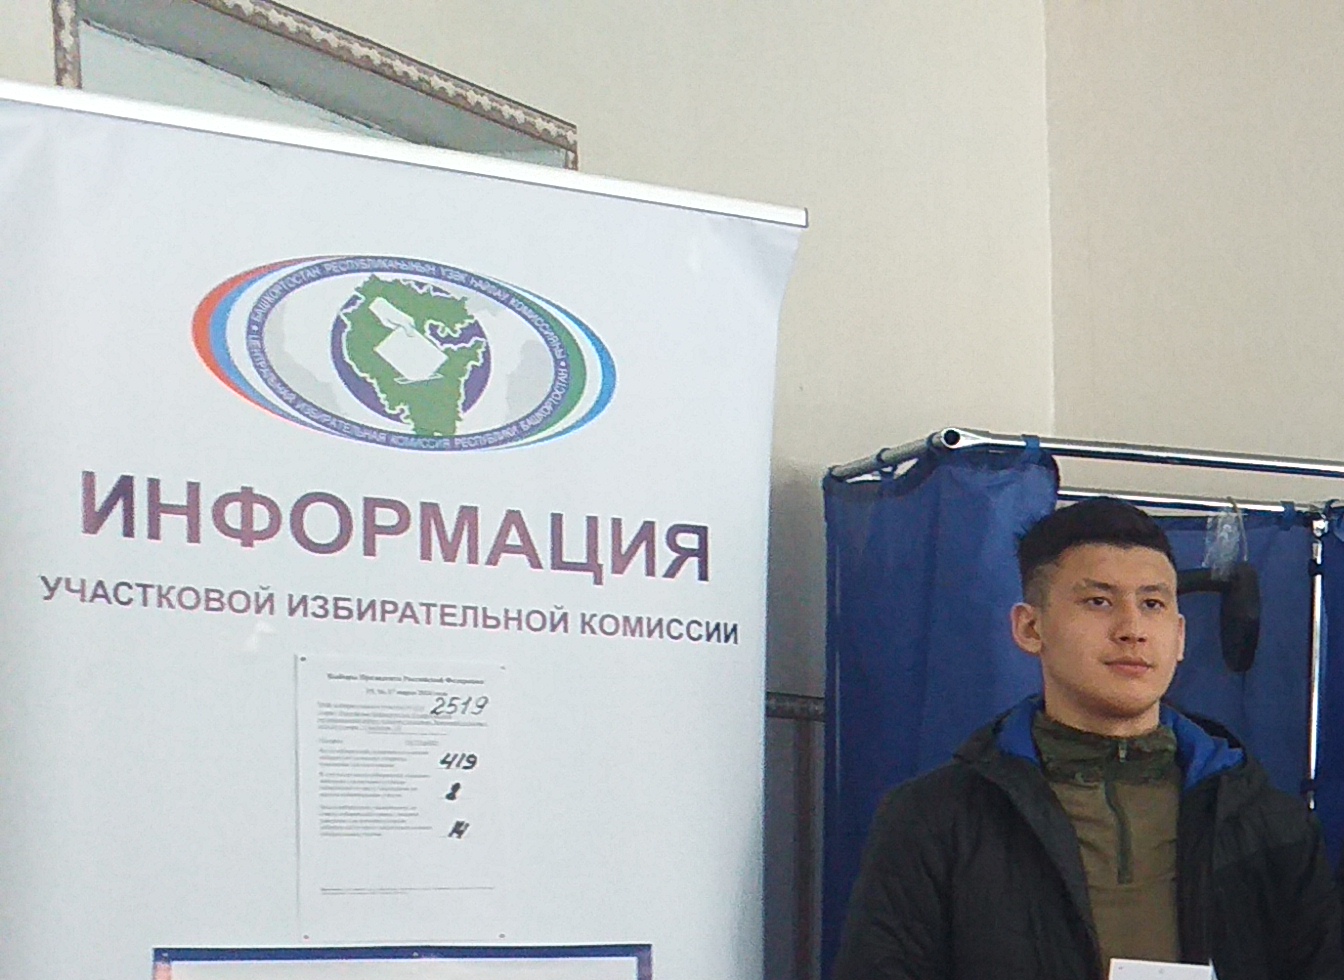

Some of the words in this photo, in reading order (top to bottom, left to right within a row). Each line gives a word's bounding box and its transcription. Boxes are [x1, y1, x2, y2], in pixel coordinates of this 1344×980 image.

[80, 469, 712, 584] ИНФОРМАЦИЯ
[39, 574, 276, 617] УЧАСТКОВОЙ
[286, 592, 569, 635] ИЗБИРАТЕЛЬНОЙ
[579, 615, 740, 646] КОМИССИИ
[430, 696, 489, 715] 2519
[439, 753, 478, 769] 419
